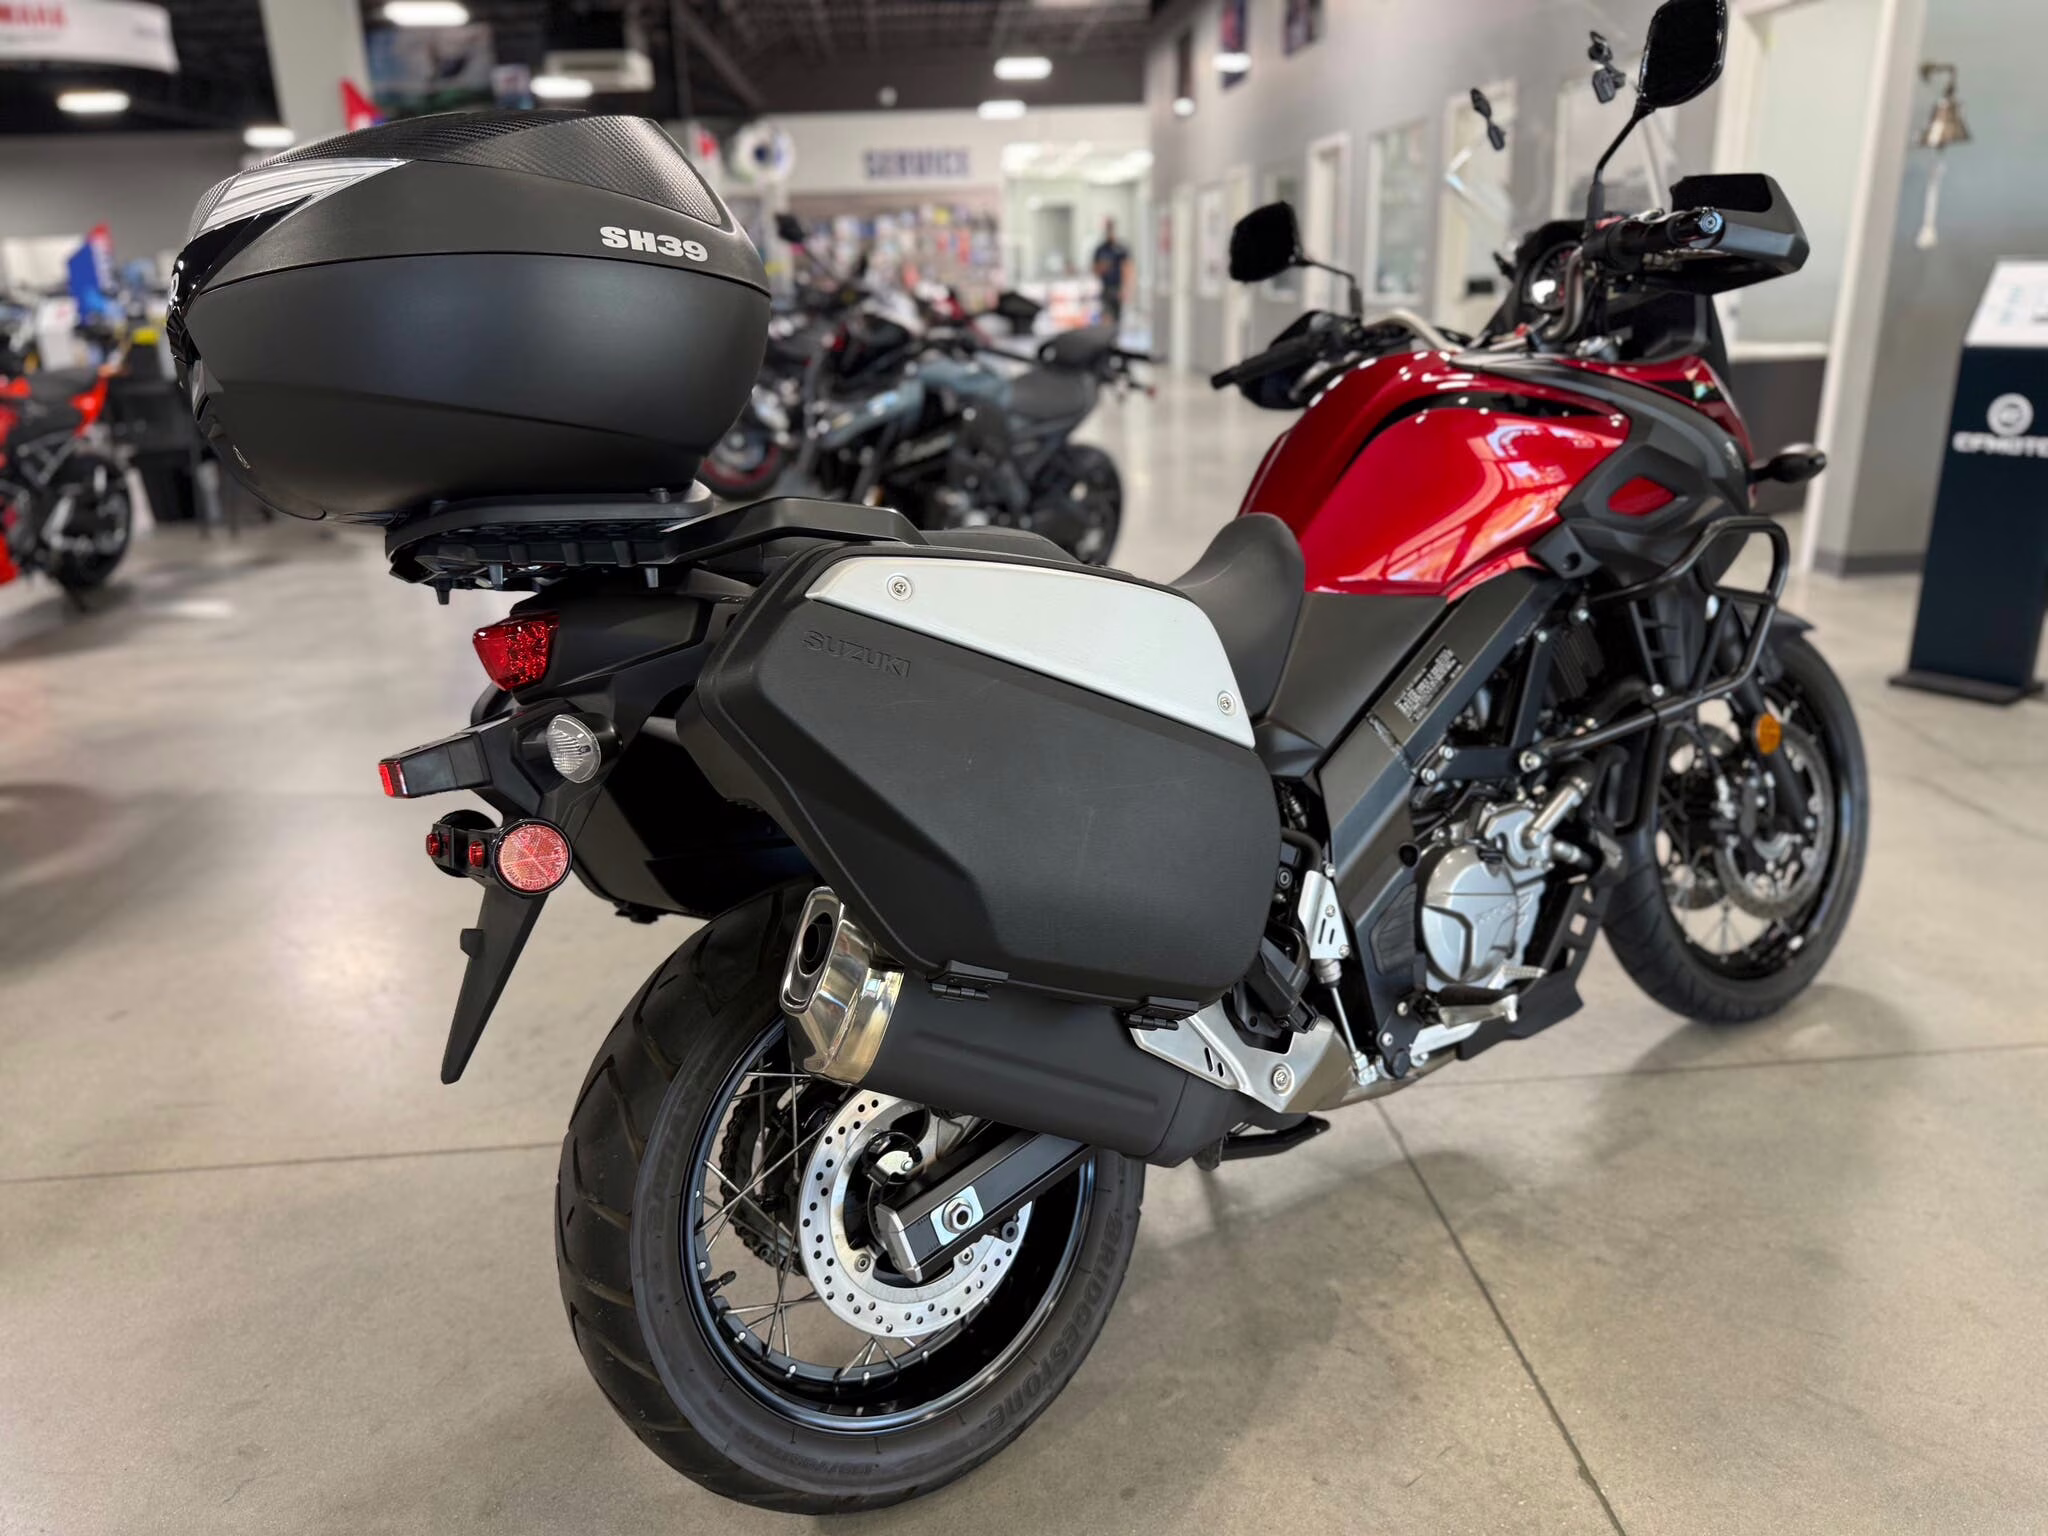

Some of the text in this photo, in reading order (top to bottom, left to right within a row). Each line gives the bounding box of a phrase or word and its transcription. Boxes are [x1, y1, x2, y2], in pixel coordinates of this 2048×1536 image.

[863, 148, 970, 180] SERVICE
[600, 226, 708, 262] SH39
[802, 629, 911, 678] SUZUKI
[986, 1211, 1124, 1431] BRIDGESTONE
